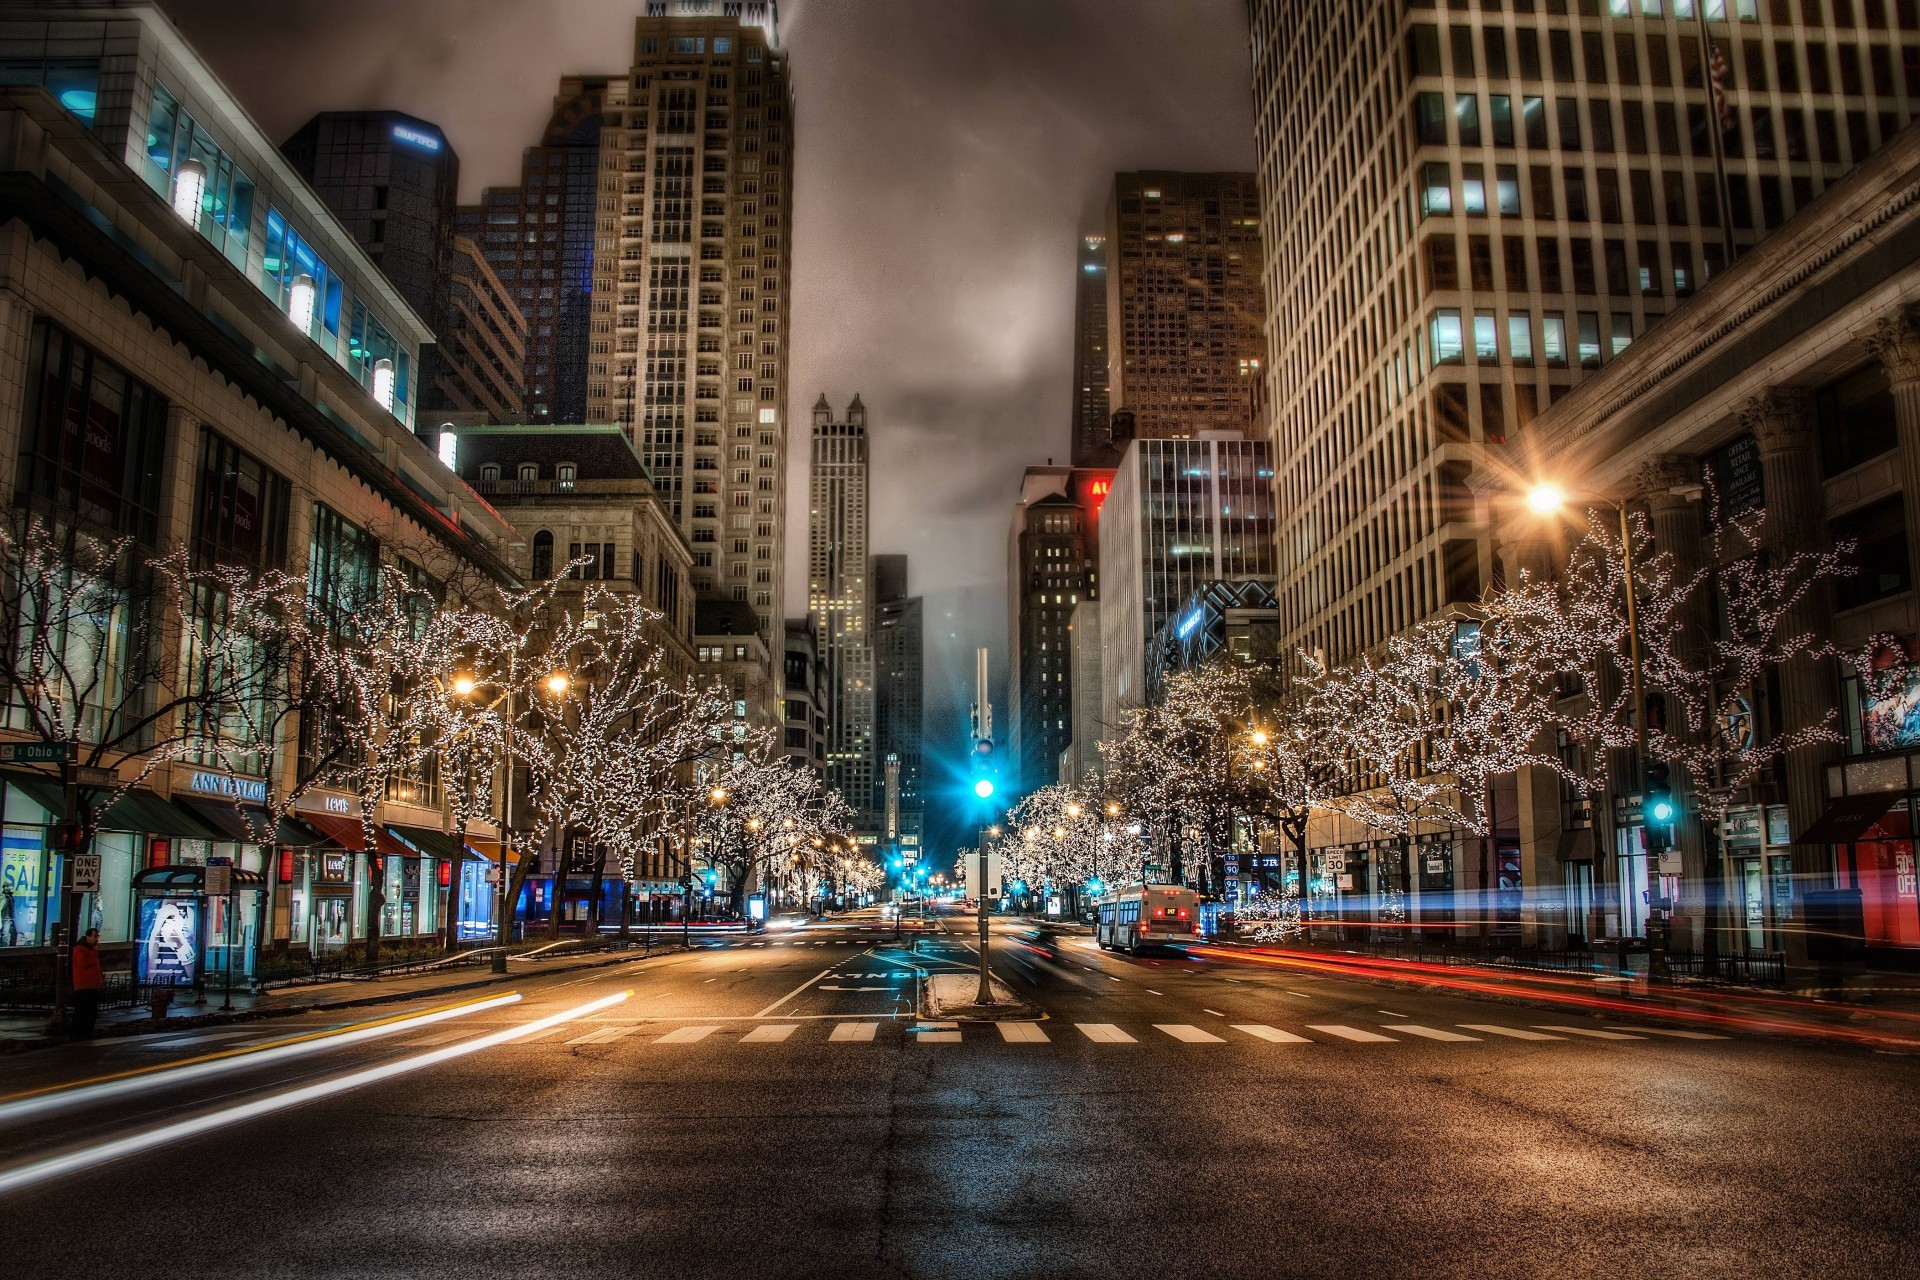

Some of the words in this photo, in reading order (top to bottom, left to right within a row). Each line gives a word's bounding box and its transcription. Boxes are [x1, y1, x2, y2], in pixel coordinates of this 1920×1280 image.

[1730, 450, 1752, 468] RETAIL
[1730, 470, 1756, 490] AVAILABLE
[27, 746, 52, 757] Ohio
[193, 773, 220, 791] ANN
[77, 858, 98, 867] ONE
[1328, 860, 1343, 870] 30
[1896, 854, 1915, 874] 50%
[76, 868, 98, 878] WAY
[1897, 874, 1916, 894] OFF
